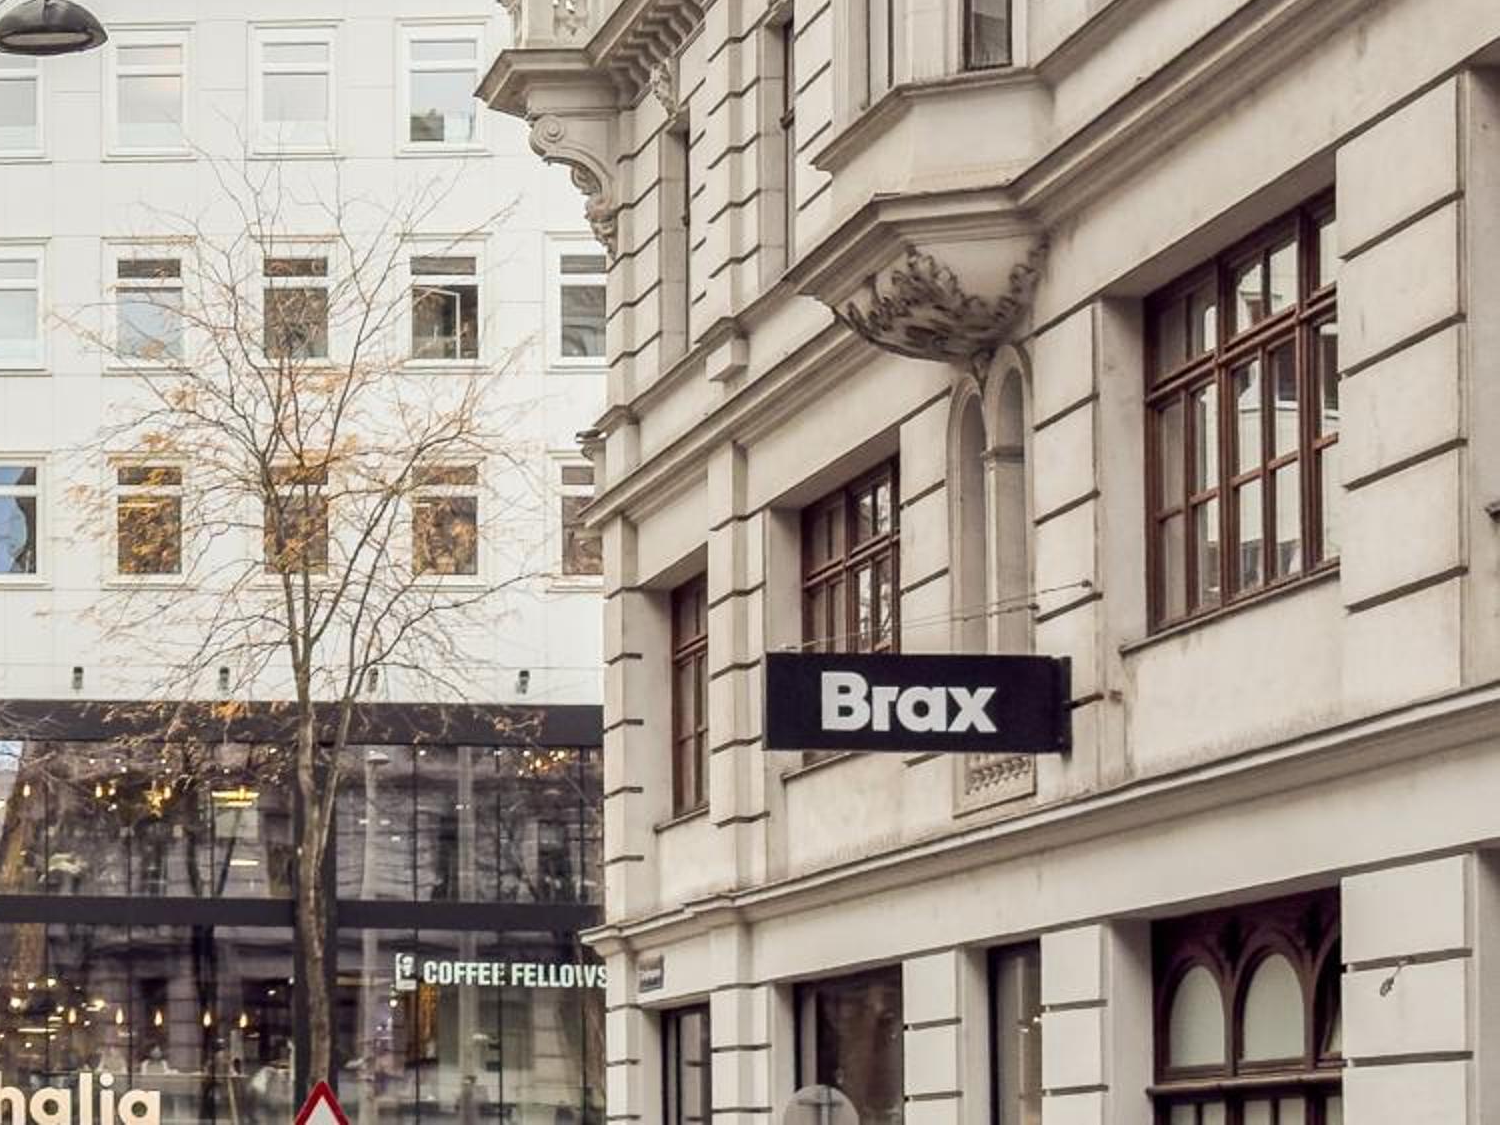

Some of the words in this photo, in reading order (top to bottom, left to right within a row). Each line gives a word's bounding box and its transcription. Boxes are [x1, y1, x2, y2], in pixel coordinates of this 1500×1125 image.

[821, 671, 998, 733] Brax
[423, 960, 505, 986] COFFEE
[511, 962, 608, 988] FELLOWS
